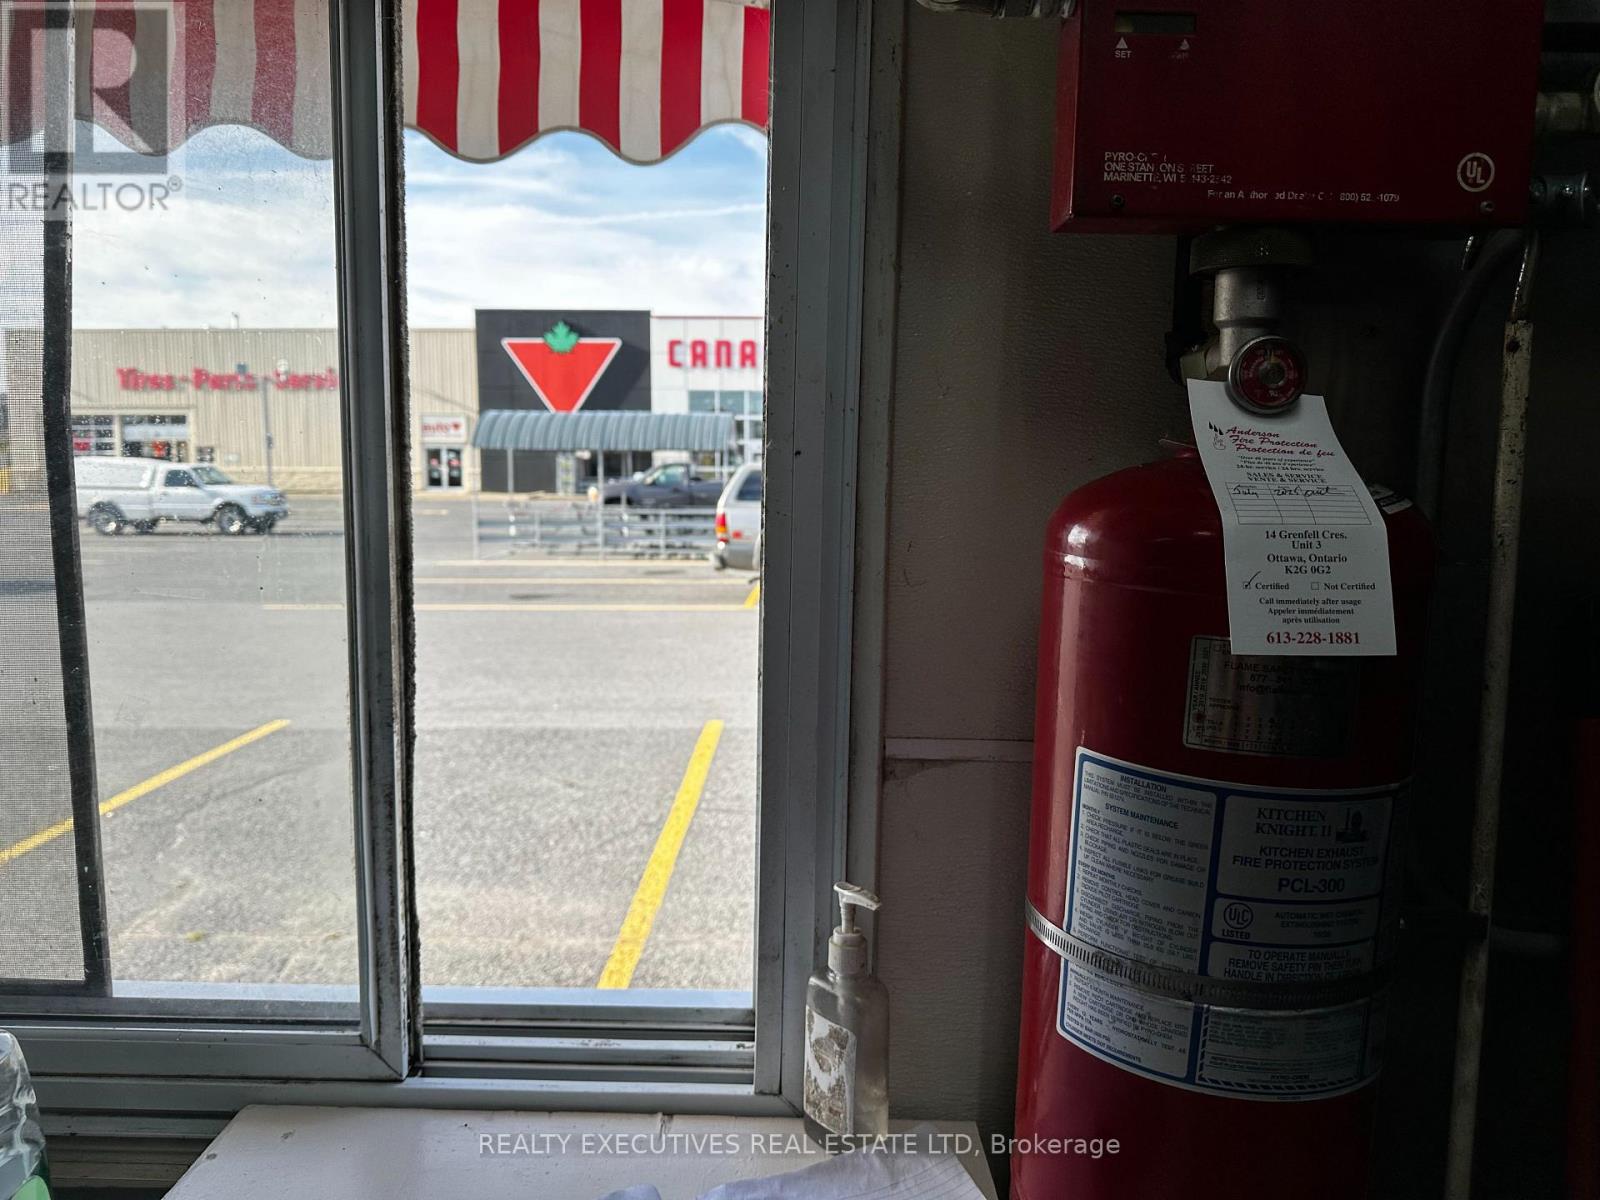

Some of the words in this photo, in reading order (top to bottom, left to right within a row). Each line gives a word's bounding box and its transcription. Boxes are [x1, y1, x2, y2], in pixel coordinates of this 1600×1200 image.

[1114, 50, 1132, 59] SET
[1104, 162, 1125, 171] ONE
[1127, 162, 1177, 173] STANON
[1467, 159, 1486, 185] UL
[1224, 191, 1235, 199] an
[668, 340, 757, 369] CANA
[1226, 426, 1280, 438] Anderson
[1229, 435, 1255, 445] Fire
[1259, 437, 1317, 448] Protection
[1235, 443, 1294, 456] Protection
[1317, 449, 1335, 458] feu
[1265, 531, 1276, 540] 14
[1279, 530, 1319, 540] Grenfell
[1322, 530, 1347, 540] Cres.
[1292, 540, 1311, 550] Unit
[1313, 541, 1322, 550] 3
[1267, 554, 1307, 564] Ottawa,
[1309, 554, 1348, 563] Ontario
[1285, 566, 1308, 575] K2G
[1310, 566, 1332, 575] 0G2
[1275, 598, 1320, 607] immediately
[1268, 608, 1297, 617] Appeler
[1282, 617, 1302, 625] après
[1304, 616, 1340, 624] utilisation
[1266, 631, 1361, 644] 613-228-1881
[1120, 774, 1167, 792] INSTALLATION
[1105, 802, 1129, 817] SYSTEM
[1130, 810, 1179, 830] MAINTENANCE
[1256, 807, 1326, 822] KITCHEN
[1255, 823, 1319, 837] KNIGHT
[1321, 824, 1332, 837] II
[1259, 846, 1314, 859] KITCHEN
[1316, 846, 1366, 859] EXHAUST
[1232, 855, 1263, 868] FIRE
[1264, 860, 1342, 871] PROTECTION
[1278, 877, 1345, 894] PCL-300
[1228, 906, 1249, 926] ULC
[1222, 929, 1251, 940] LISTED
[1248, 950, 1262, 960] TO
[1263, 951, 1305, 962] OPERATE
[1228, 959, 1269, 971] REMOVE
[1270, 962, 1307, 973] SAFETY
[1223, 968, 1265, 981] HANDLE
[1266, 971, 1277, 982] IN
